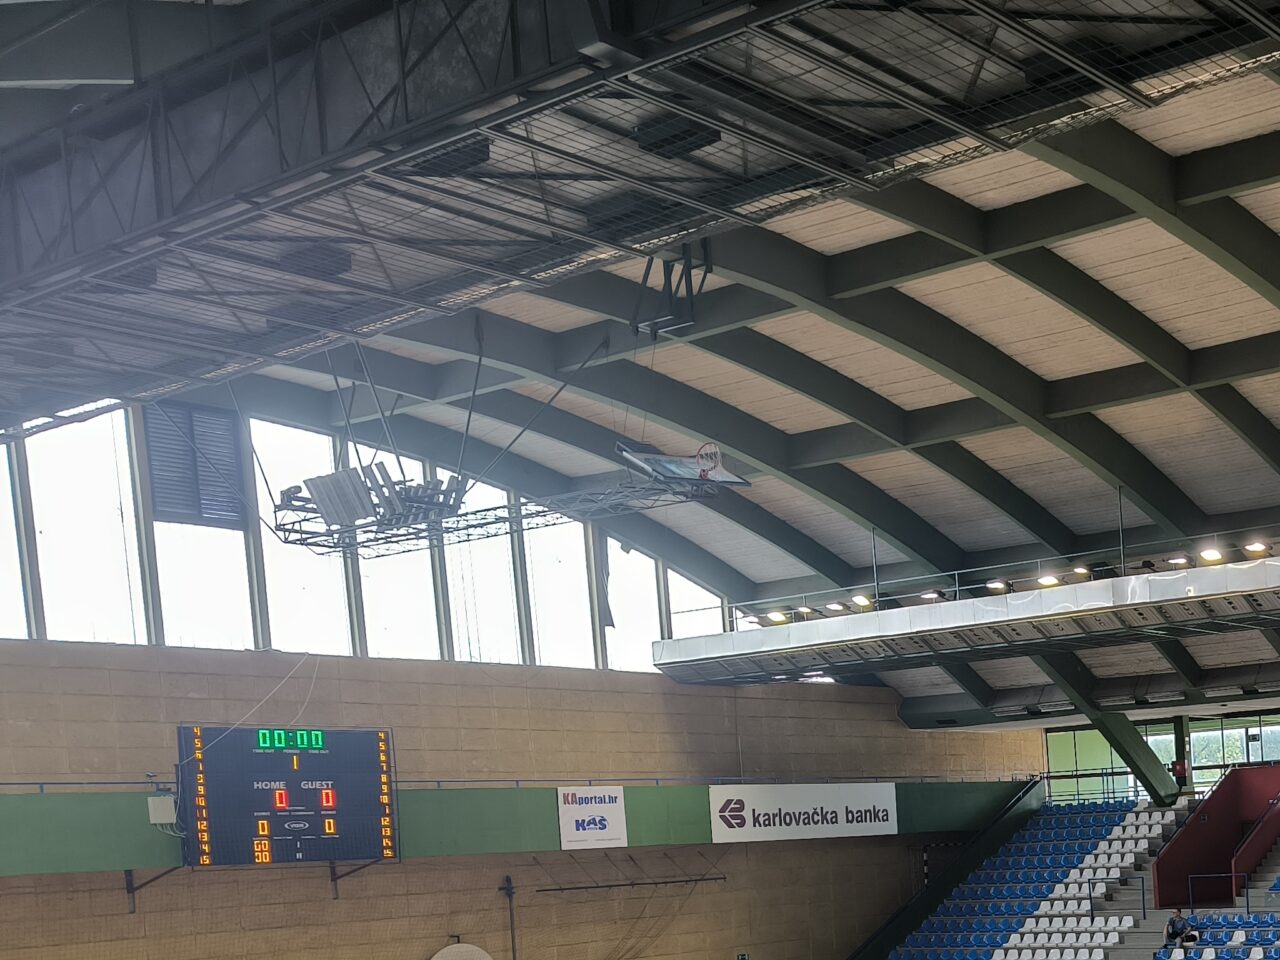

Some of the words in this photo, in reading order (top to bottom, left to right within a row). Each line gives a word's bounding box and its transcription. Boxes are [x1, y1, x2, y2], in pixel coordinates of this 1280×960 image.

[258, 729, 323, 748] 00:00
[253, 781, 287, 789] HOME
[300, 781, 334, 789] GUEST
[275, 790, 287, 807] 0
[322, 789, 333, 806] 0
[563, 793, 618, 806] KAportal.hr
[752, 807, 839, 828] karlovačka
[845, 805, 889, 824] banka
[258, 820, 269, 835] 0
[325, 819, 335, 833] 0
